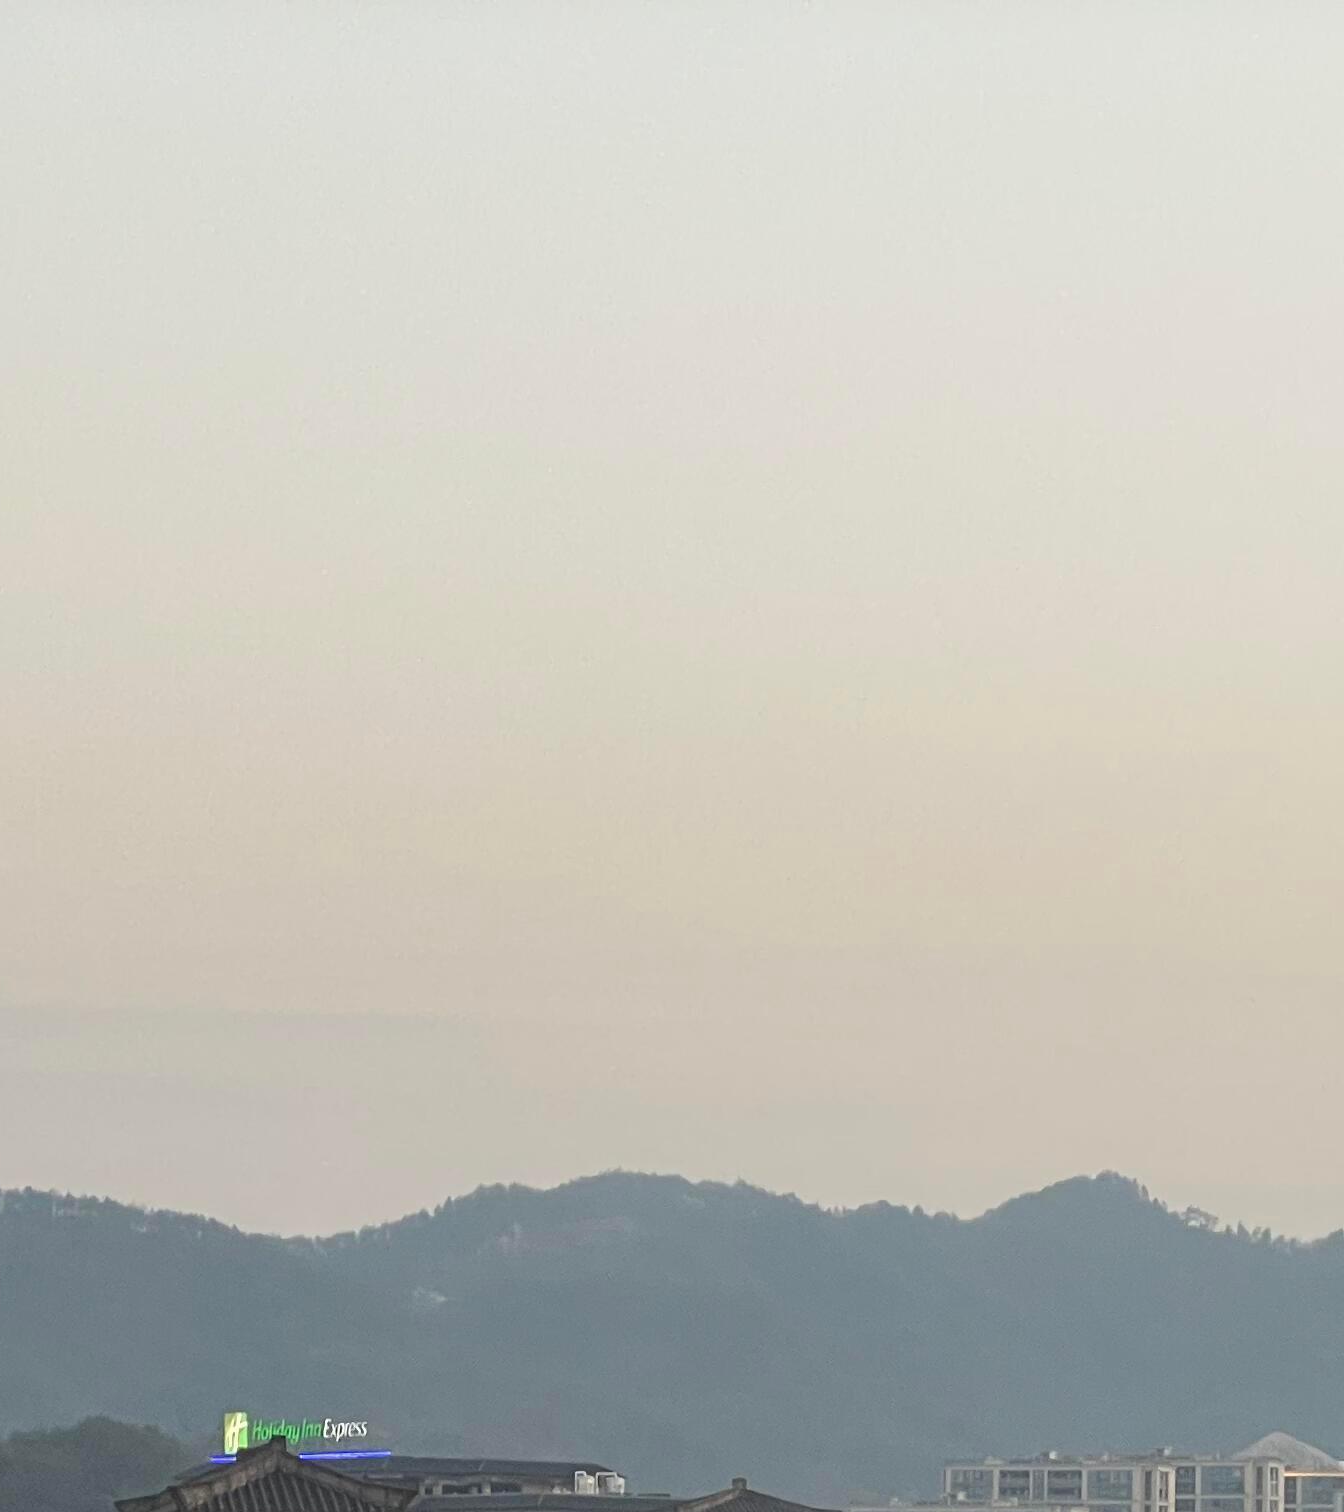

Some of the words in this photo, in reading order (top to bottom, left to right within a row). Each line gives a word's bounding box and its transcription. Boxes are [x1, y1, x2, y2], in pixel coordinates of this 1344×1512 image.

[252, 1418, 301, 1444] Holiday
[301, 1417, 323, 1438] Inn
[323, 1418, 368, 1442] Express
